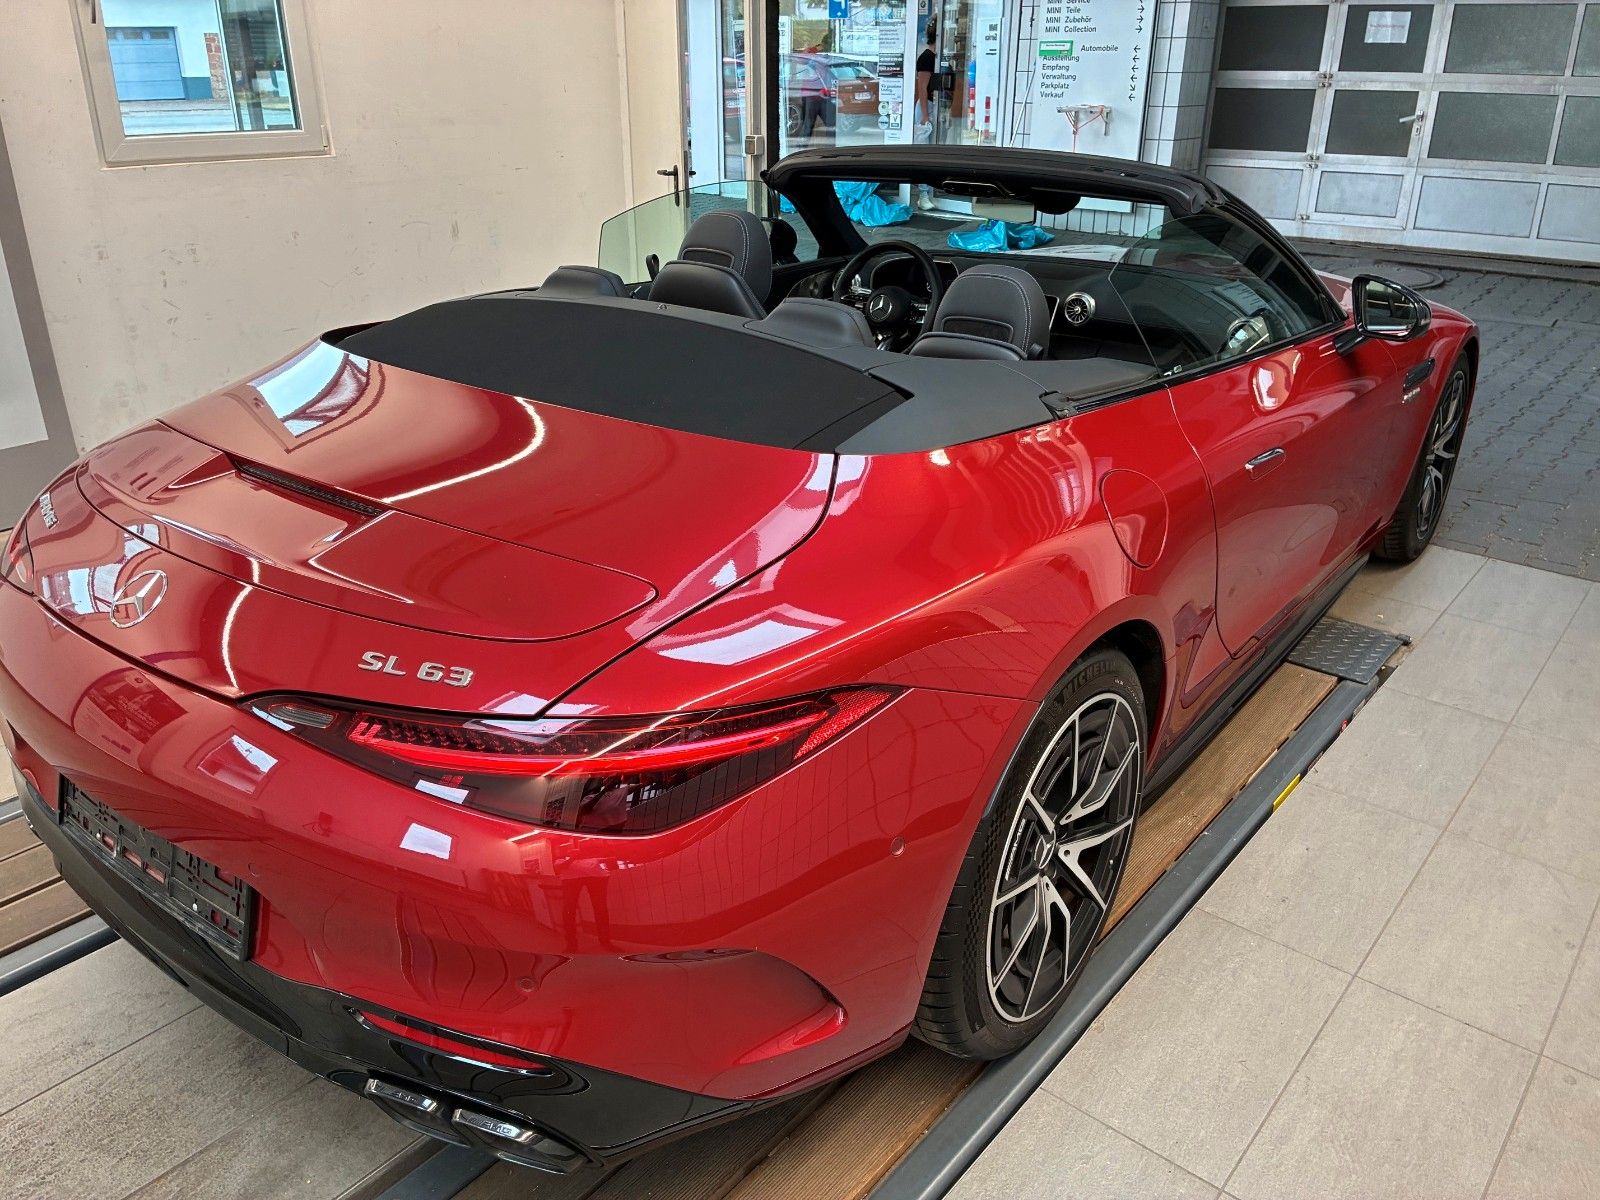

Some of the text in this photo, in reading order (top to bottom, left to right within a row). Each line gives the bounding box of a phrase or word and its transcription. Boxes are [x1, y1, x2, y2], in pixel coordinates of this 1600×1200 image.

[1042, 54, 1080, 62] Ausstellung
[1042, 63, 1070, 71] Empfang
[1041, 73, 1077, 81] Verwaltung
[1040, 82, 1070, 90] Parkplatz
[357, 651, 474, 688] SL 63
